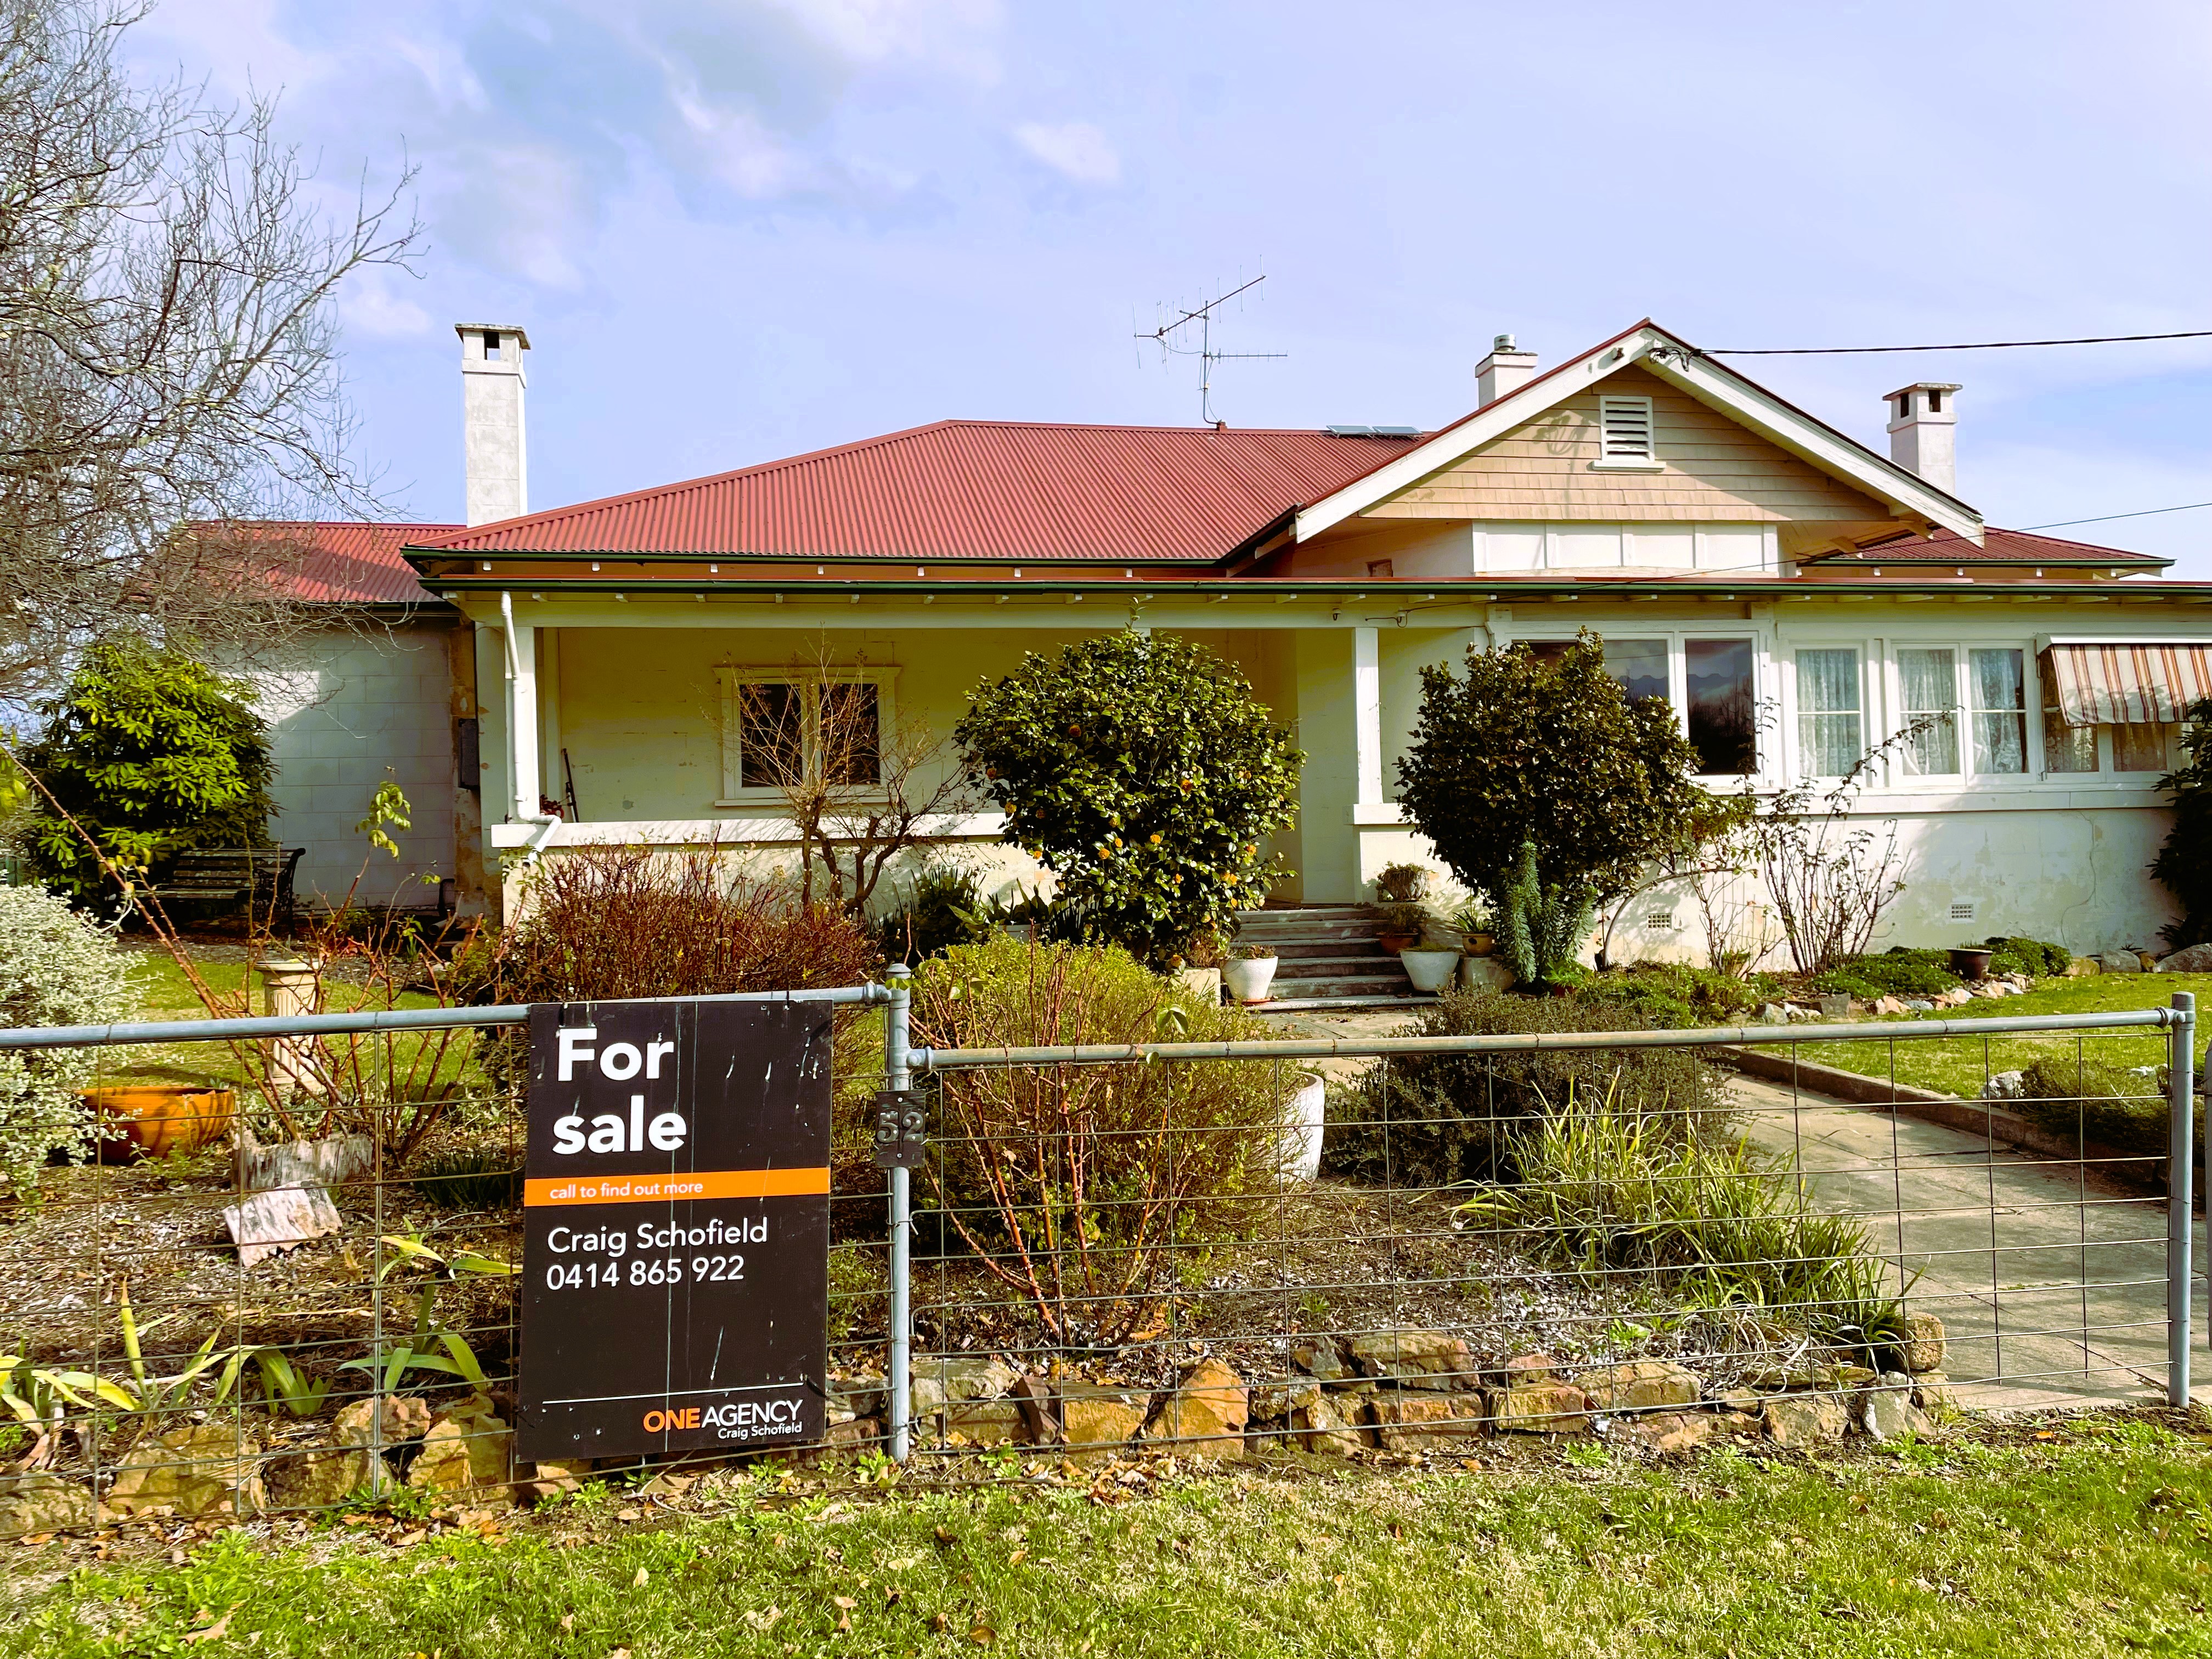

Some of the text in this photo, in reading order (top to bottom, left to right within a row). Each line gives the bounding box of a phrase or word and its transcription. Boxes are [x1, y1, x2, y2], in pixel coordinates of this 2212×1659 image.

[558, 1028, 674, 1081] For
[552, 1095, 686, 1155] sale
[877, 1111, 924, 1143] 52
[550, 1182, 703, 1199] call to find out more
[548, 1216, 768, 1257] Craig Schofield
[546, 1255, 745, 1290] 0414 865 922
[718, 1421, 803, 1440] Craig Schofield
